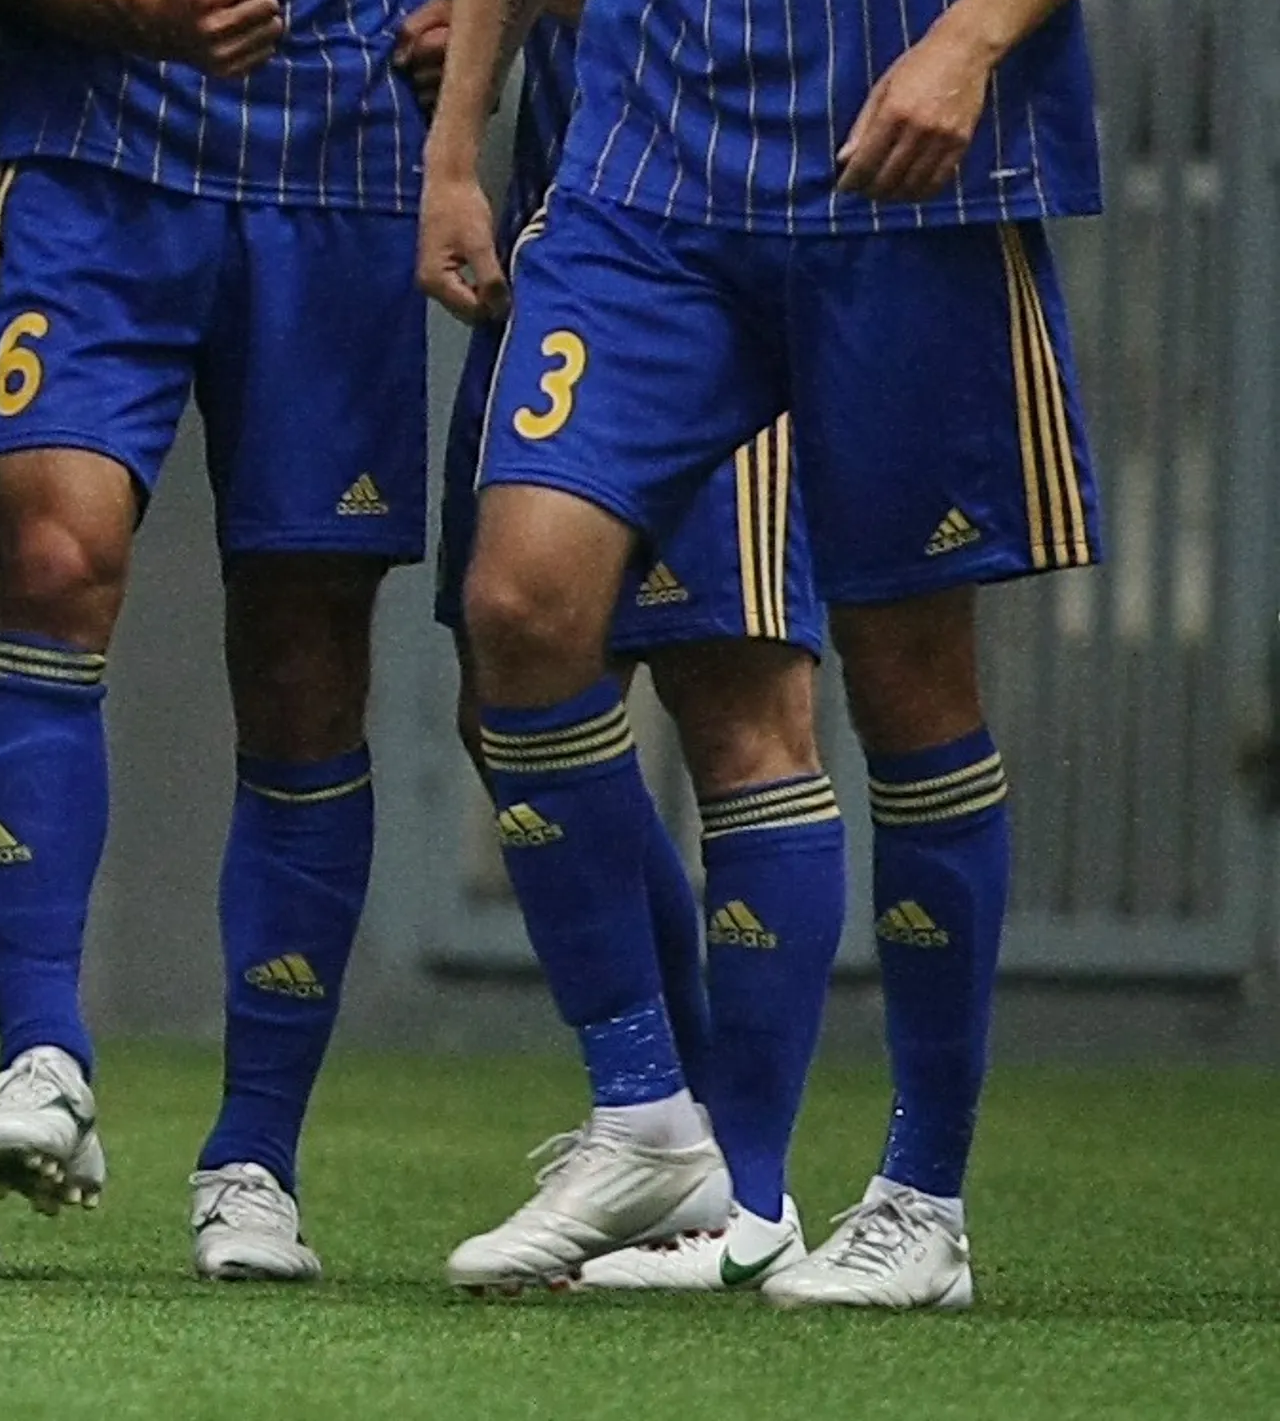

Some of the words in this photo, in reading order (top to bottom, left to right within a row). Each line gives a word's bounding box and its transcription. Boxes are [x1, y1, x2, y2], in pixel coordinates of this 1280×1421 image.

[513, 329, 589, 442] 3
[335, 500, 389, 516] adidas
[635, 586, 689, 607] adidas
